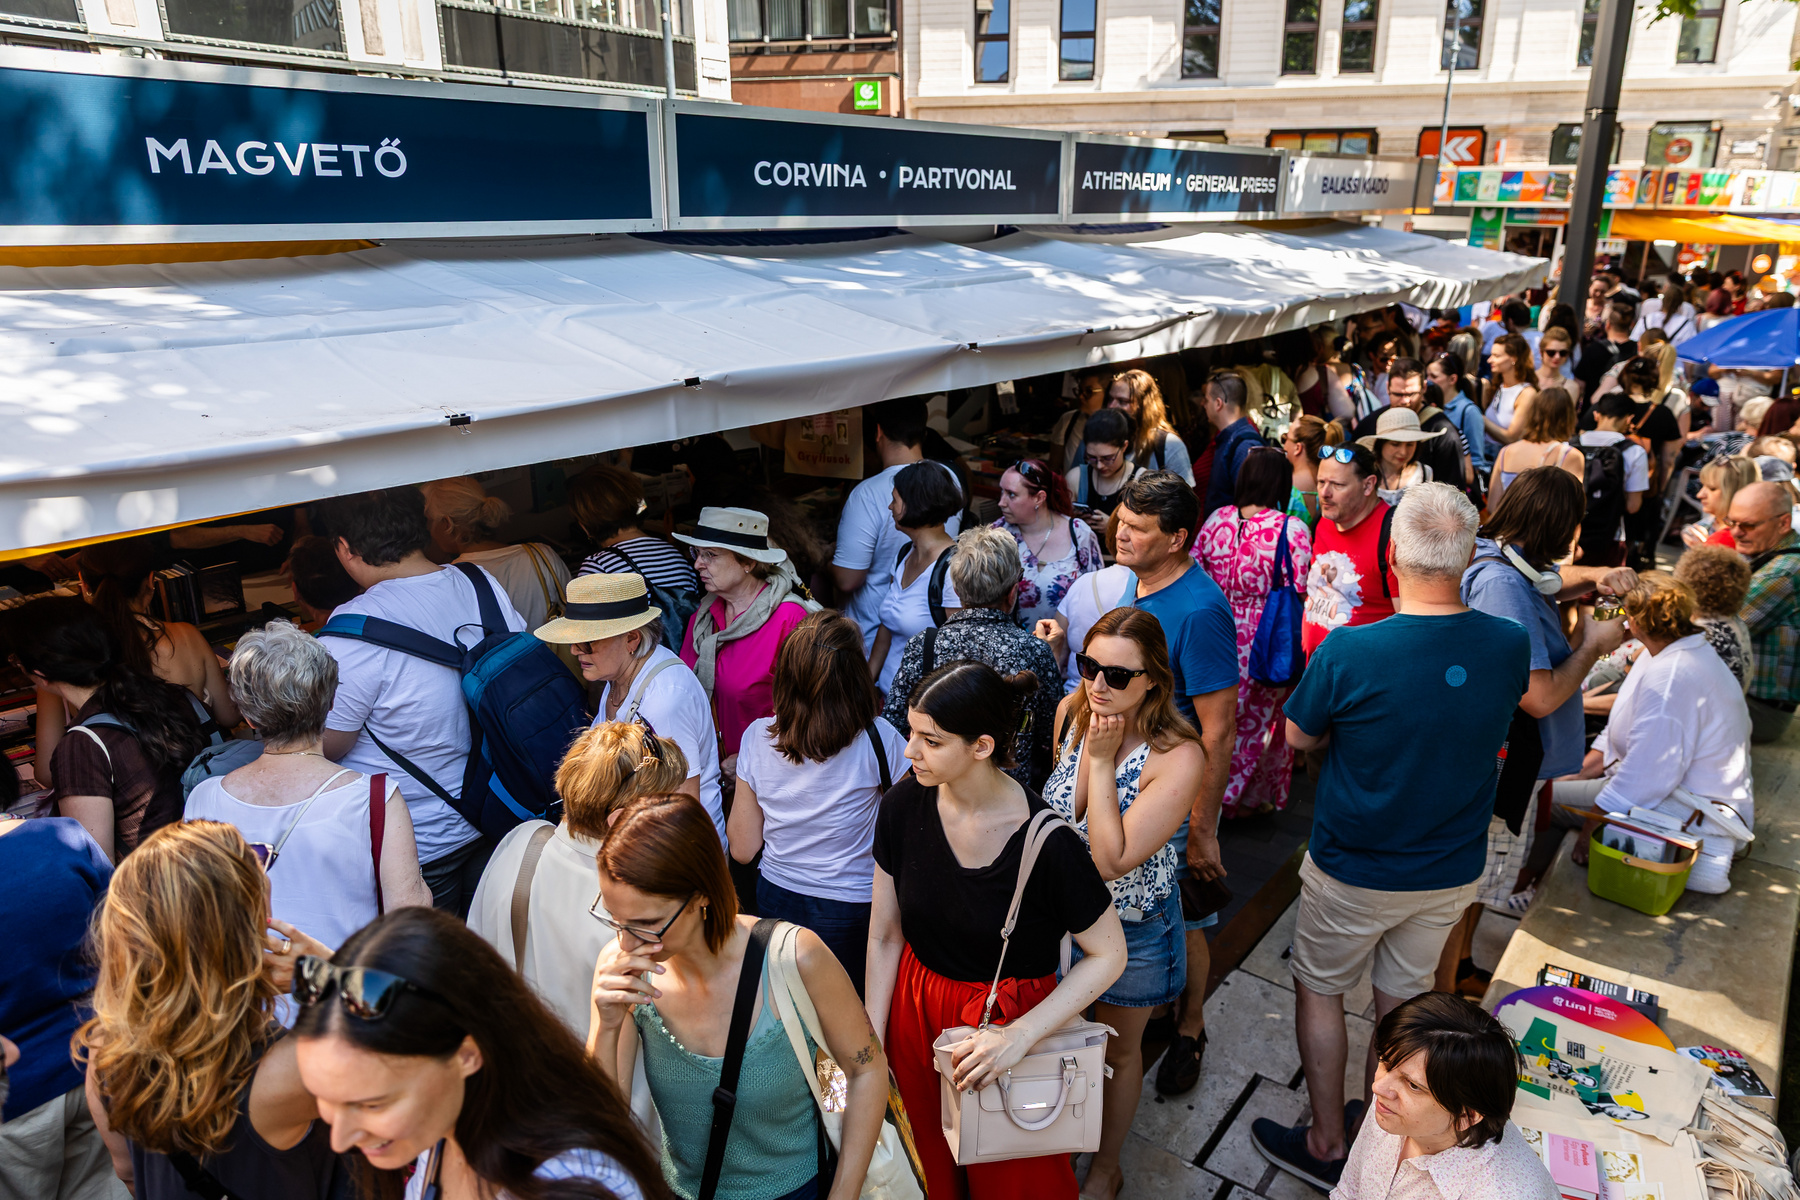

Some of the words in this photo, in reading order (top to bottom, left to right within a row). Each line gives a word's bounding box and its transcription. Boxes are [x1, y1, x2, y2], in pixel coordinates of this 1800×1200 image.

[145, 136, 408, 178] MAGVETŐ
[754, 160, 867, 189] CORVINA
[898, 165, 1016, 191] PARTVONAL
[1081, 171, 1171, 192] ATHENAEUM
[1186, 174, 1239, 193] GENERAL
[1240, 176, 1276, 194] PRESS
[1321, 176, 1359, 195] BALASSI
[1362, 174, 1390, 195] KIADÓ
[797, 450, 851, 465] Gryllusok
[1565, 999, 1586, 1012] Líra
